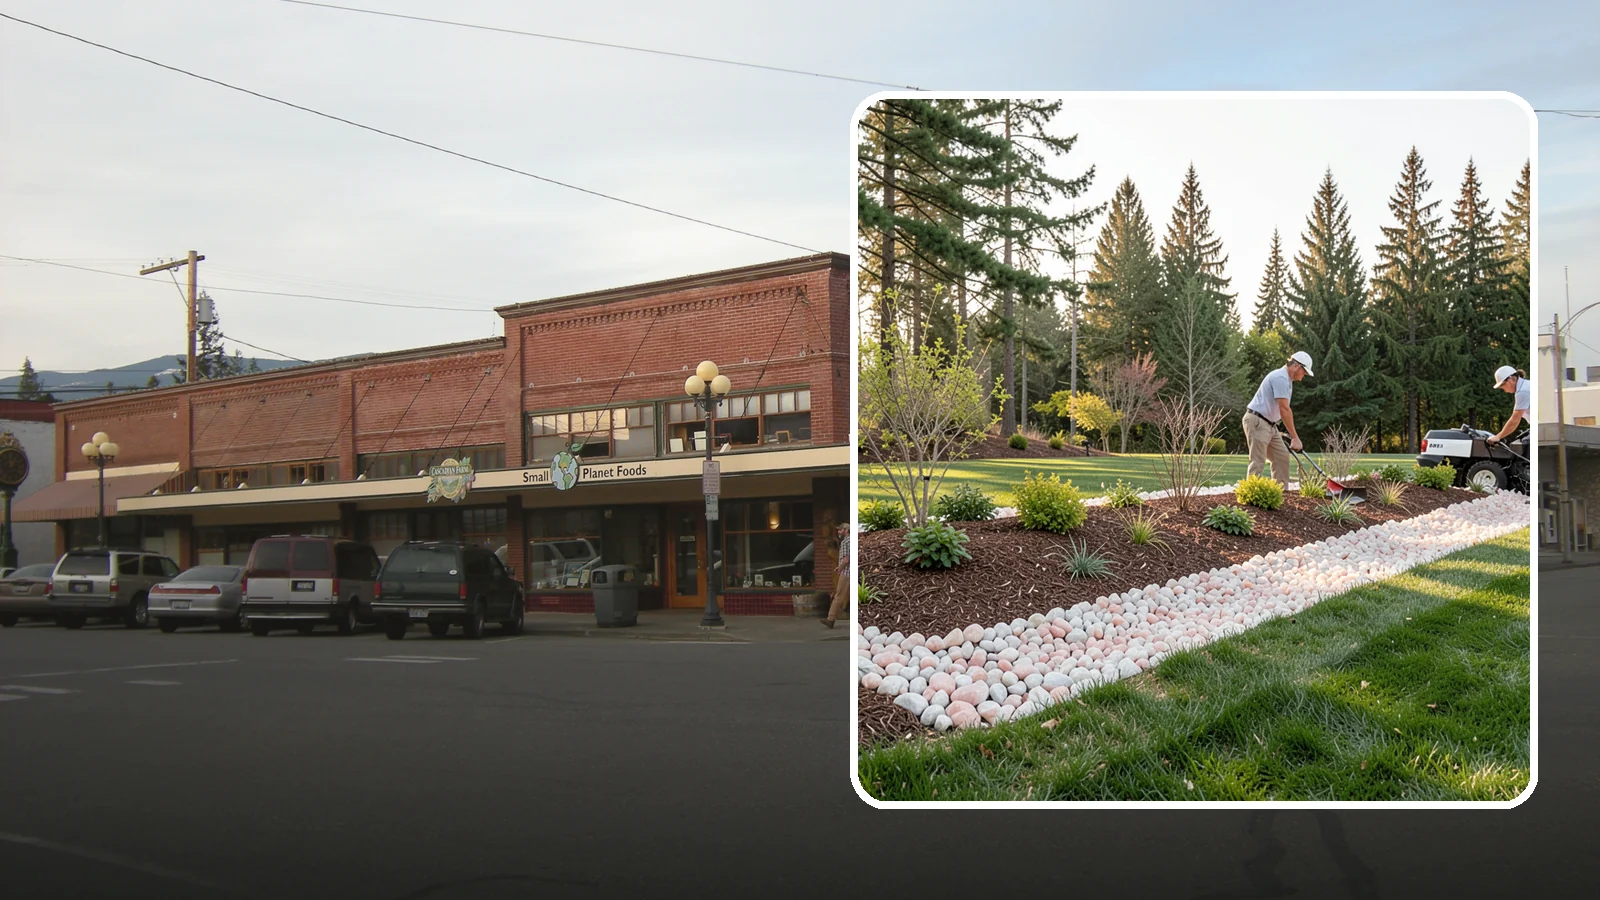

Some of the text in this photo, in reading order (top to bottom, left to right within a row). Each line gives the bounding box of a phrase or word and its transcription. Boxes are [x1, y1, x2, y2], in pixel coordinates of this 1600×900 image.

[523, 464, 647, 483] Small Planet Foods
